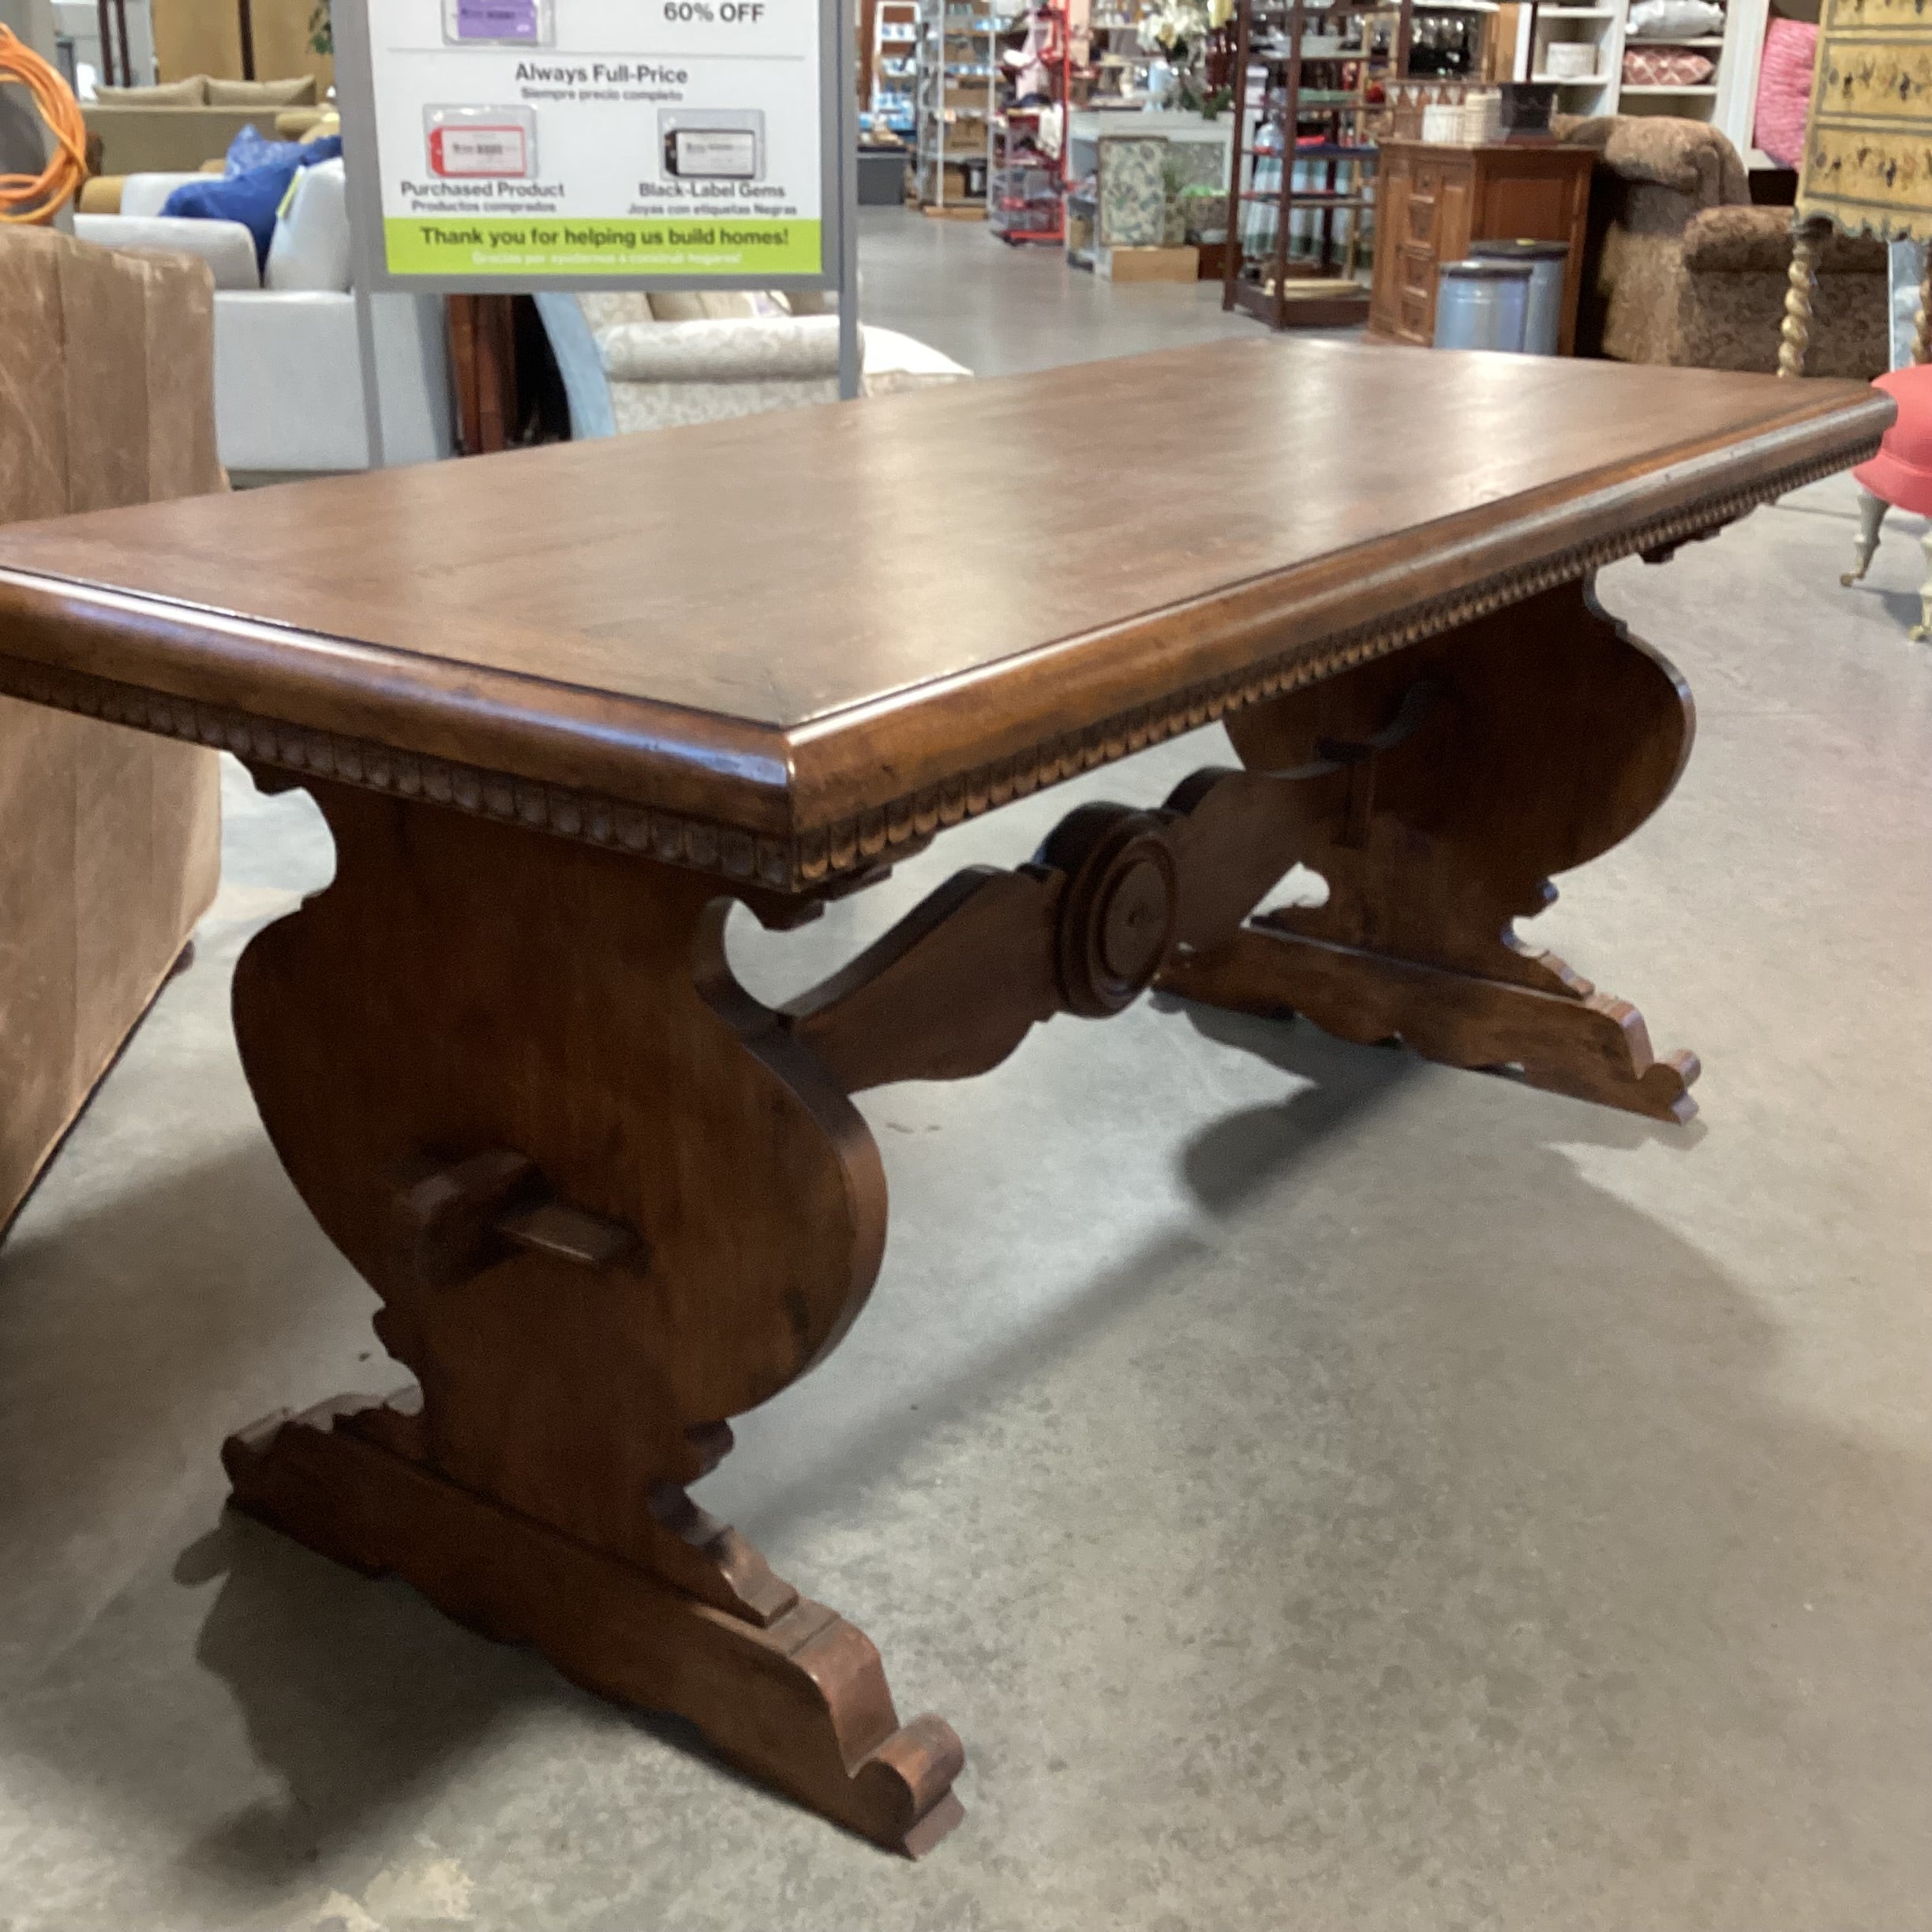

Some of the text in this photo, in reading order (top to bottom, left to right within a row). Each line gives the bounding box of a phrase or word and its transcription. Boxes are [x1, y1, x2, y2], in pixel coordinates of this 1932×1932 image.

[664, 2, 764, 21] 60% OFF
[515, 63, 688, 84] Always Full-Price
[401, 182, 565, 197] Purchased Product
[638, 182, 786, 197] Black-Label Gems
[421, 227, 788, 248] Thank you for helping us build homes!
